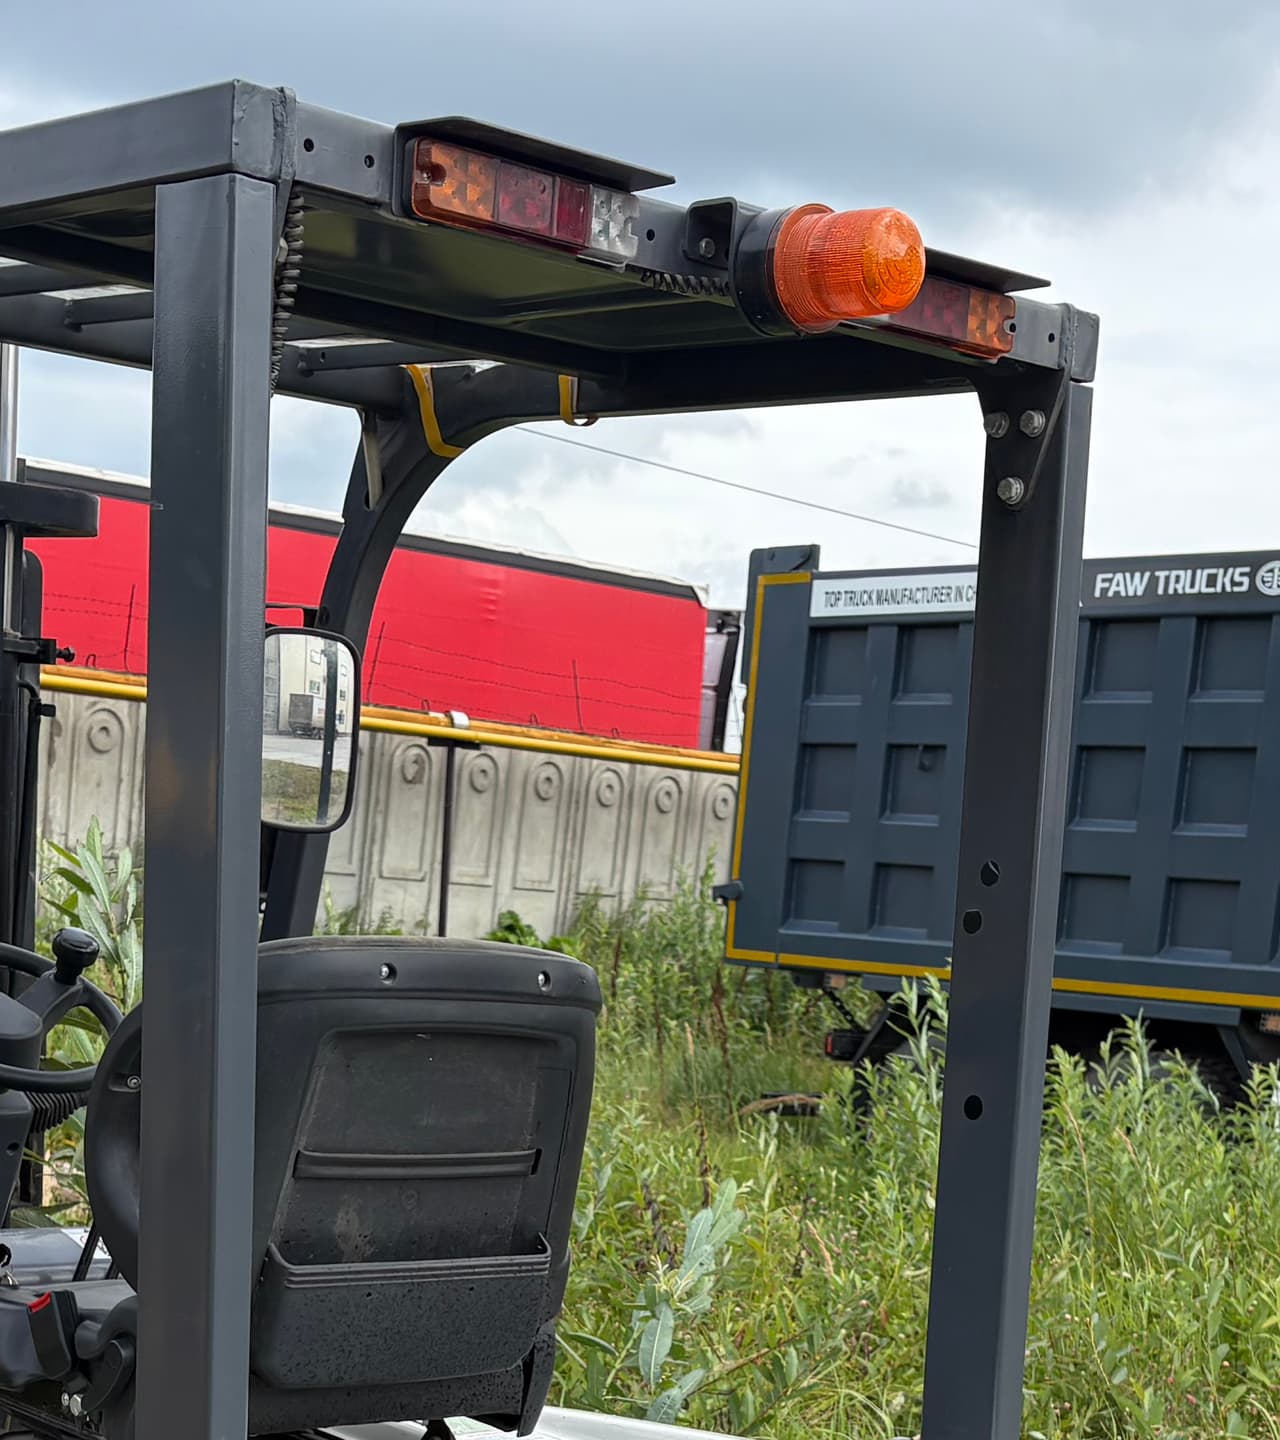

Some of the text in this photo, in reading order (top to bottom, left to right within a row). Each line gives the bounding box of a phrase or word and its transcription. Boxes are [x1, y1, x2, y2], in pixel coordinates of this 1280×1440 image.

[1094, 566, 1251, 598] FAW TRUCKS
[824, 590, 843, 608] TOP
[843, 588, 875, 607] TRUCK
[876, 586, 952, 607] MANUFACTURER
[953, 585, 965, 603] IN
